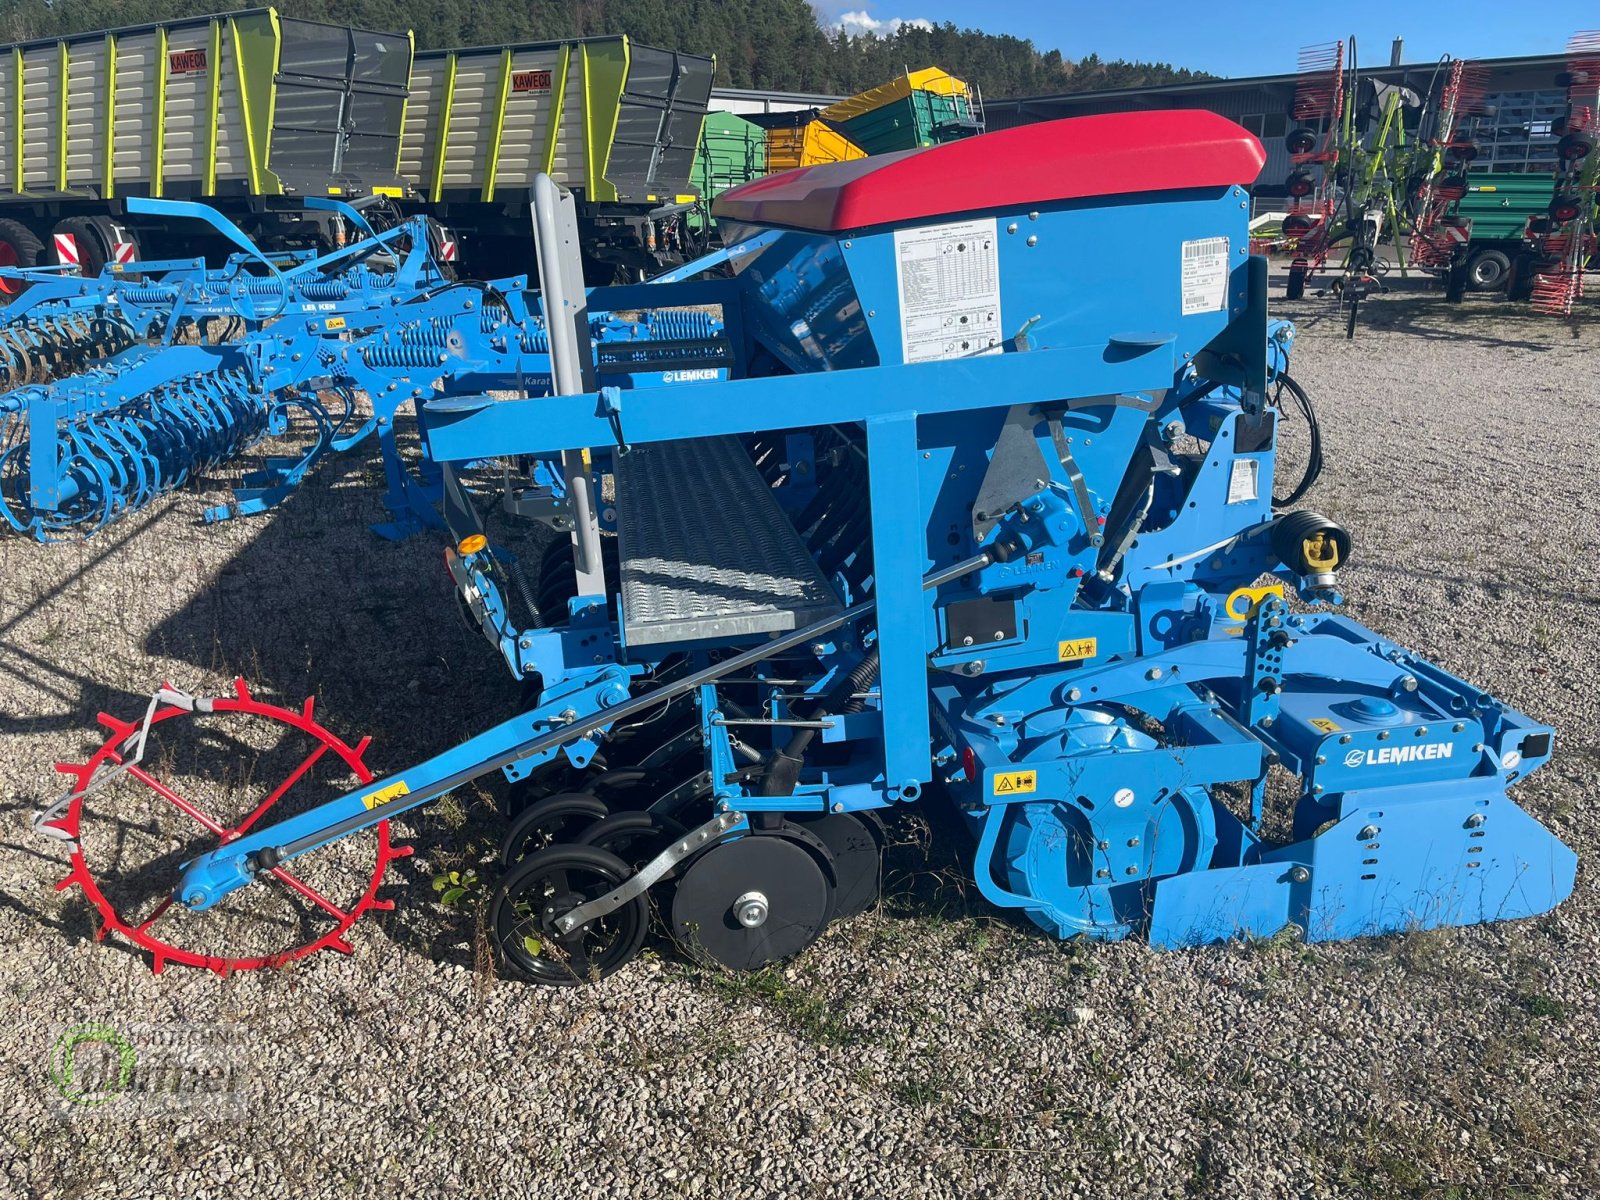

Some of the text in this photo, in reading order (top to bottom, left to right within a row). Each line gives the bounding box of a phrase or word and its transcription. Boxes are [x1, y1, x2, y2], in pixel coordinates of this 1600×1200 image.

[170, 53, 207, 70] KAWECO
[512, 73, 551, 89] KAWECO
[525, 376, 550, 386] Karat
[674, 368, 718, 382] LEMKEN
[1366, 742, 1454, 766] LEMKEN
